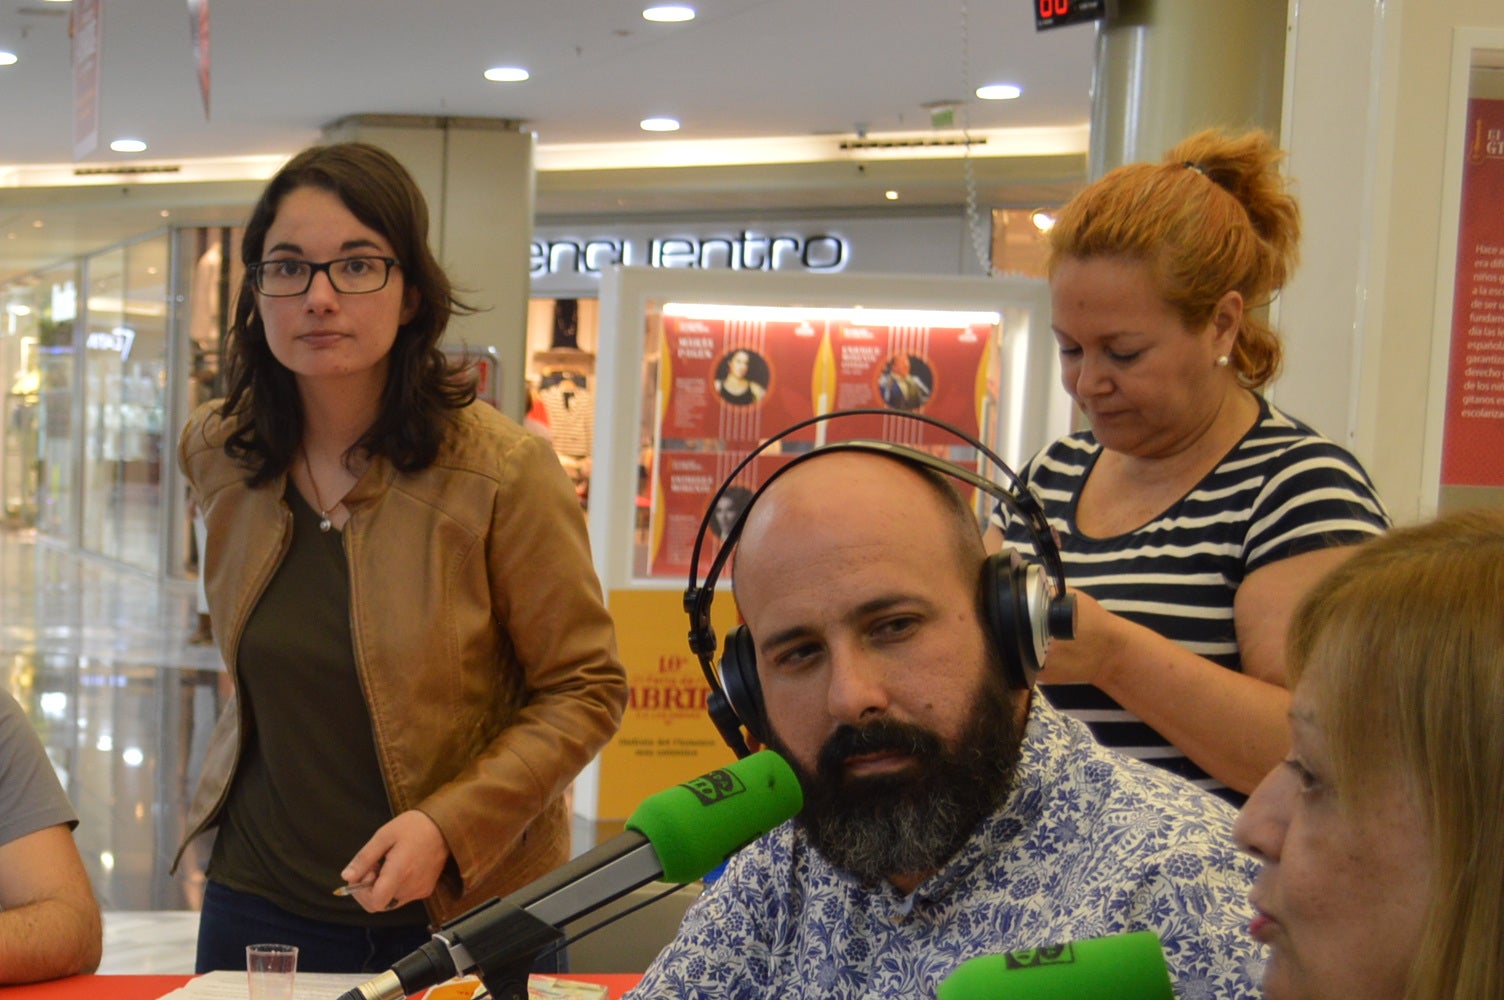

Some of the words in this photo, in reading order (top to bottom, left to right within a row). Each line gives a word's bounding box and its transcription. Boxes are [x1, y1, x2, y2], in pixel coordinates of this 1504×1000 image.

[1476, 244, 1497, 255] Hace
[1474, 260, 1488, 268] era
[1473, 273, 1497, 282] niños
[1471, 299, 1482, 309] de
[1464, 367, 1500, 377] derecho
[1464, 380, 1475, 390] de
[1477, 381, 1489, 391] los
[1463, 396, 1495, 406] gitanos
